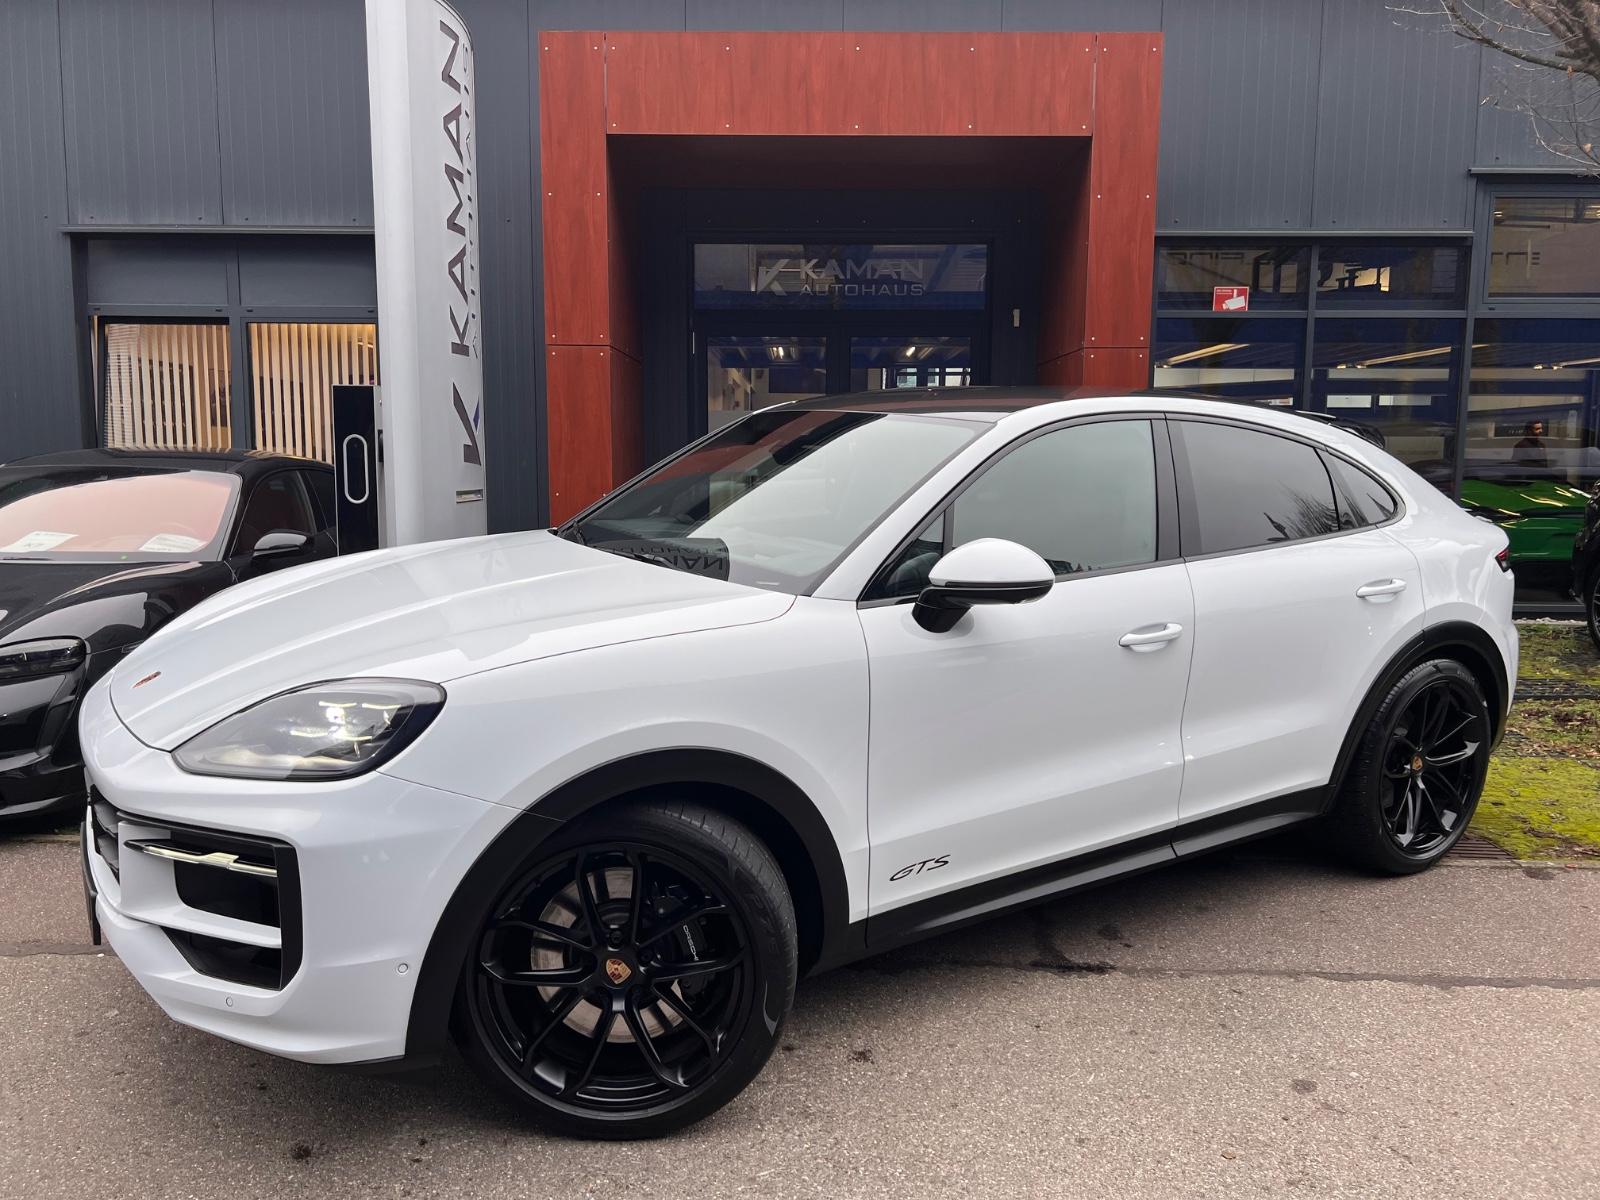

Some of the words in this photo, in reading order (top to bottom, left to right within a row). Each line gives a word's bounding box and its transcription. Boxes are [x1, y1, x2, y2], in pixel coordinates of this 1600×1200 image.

[440, 19, 470, 357] KAMAN
[800, 258, 923, 279] KAMAN
[799, 284, 923, 296] AUTOHAUS
[889, 854, 951, 881] GTS
